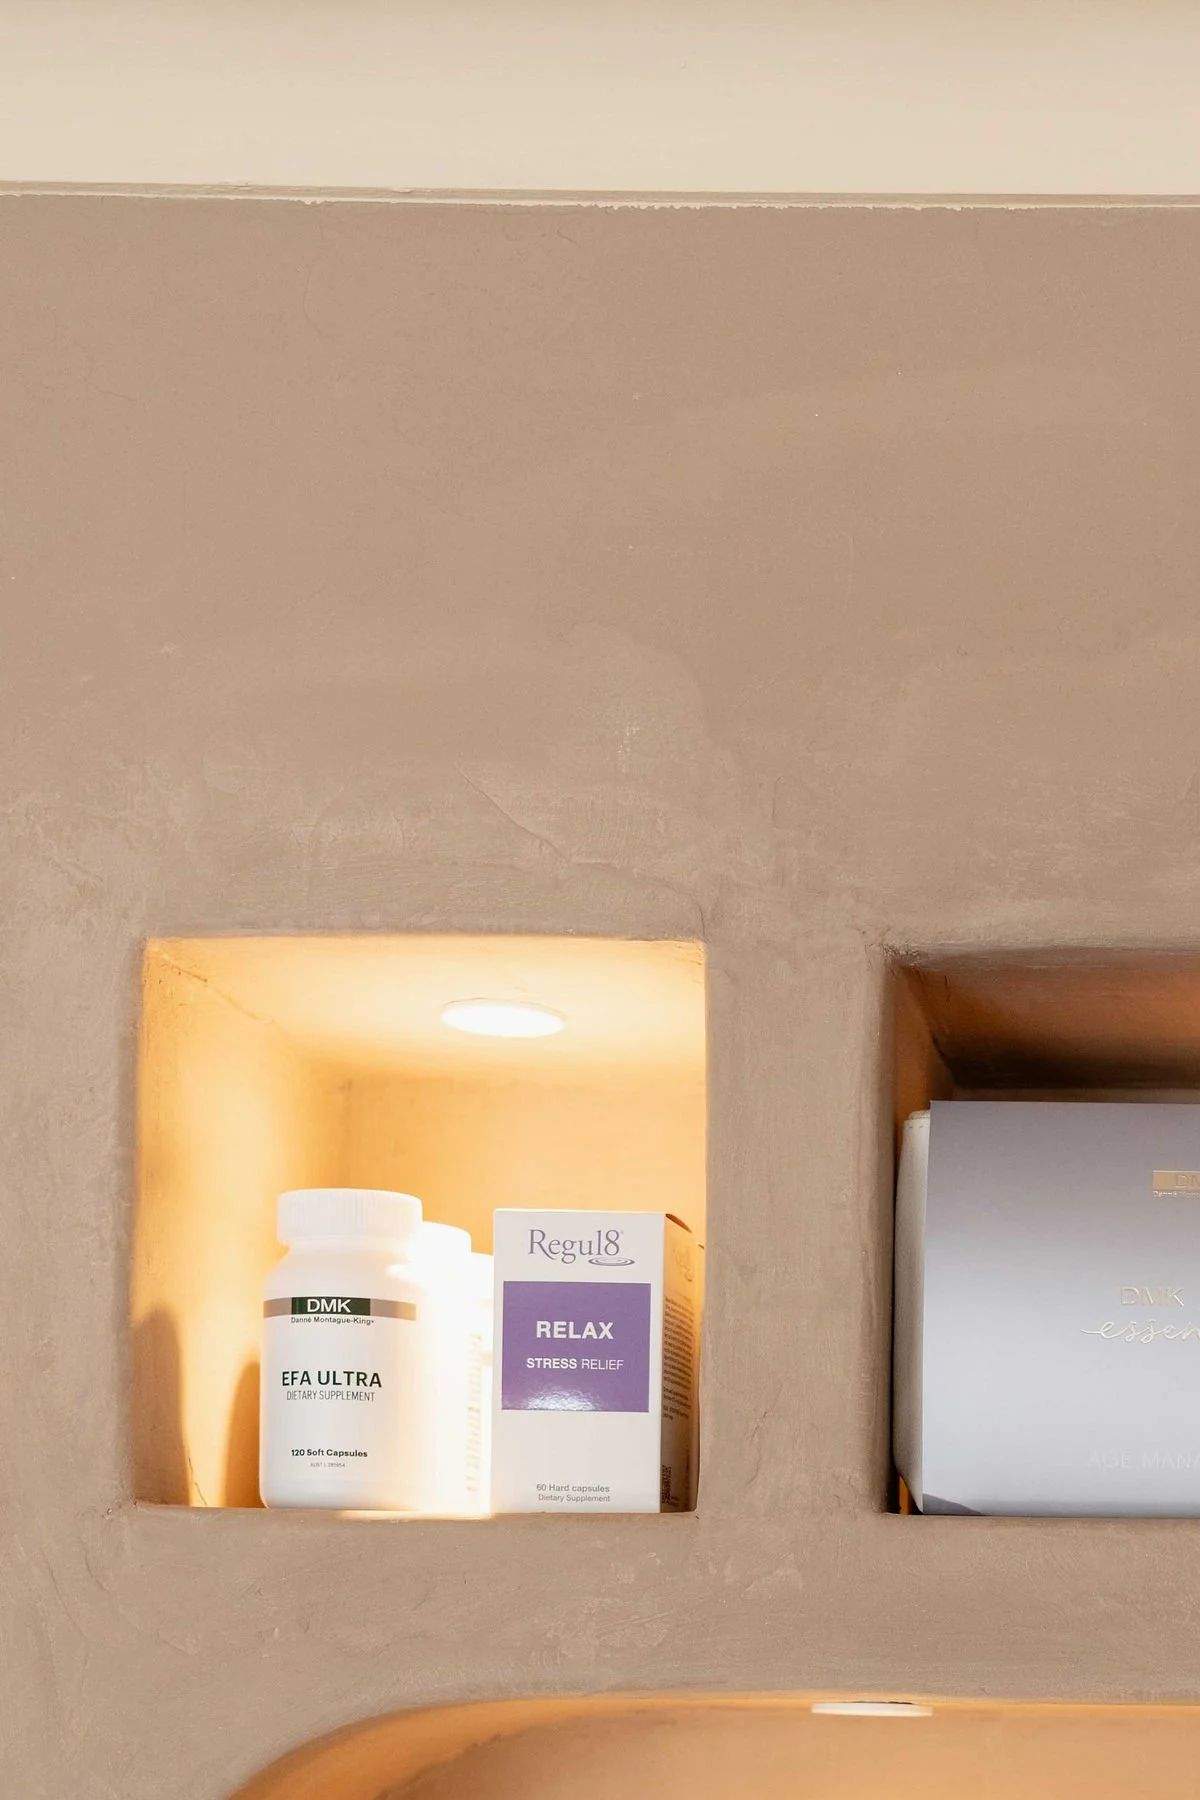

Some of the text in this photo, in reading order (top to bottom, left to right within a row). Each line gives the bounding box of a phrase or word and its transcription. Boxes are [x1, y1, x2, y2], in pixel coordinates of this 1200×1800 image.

[527, 1229, 621, 1264] Regul8
[1120, 1286, 1185, 1307] DMK
[308, 1299, 351, 1313] DMK
[536, 1320, 614, 1340] RELAX
[527, 1357, 624, 1371] STRESS RELIEF
[281, 1370, 383, 1389] EFA ULTRA
[286, 1390, 375, 1402] DIETARY SUPPLEMENT
[291, 1449, 369, 1460] 120 Soft Capsules
[1087, 1449, 1133, 1469] AGE
[536, 1484, 610, 1495] 60 Hard capsules
[538, 1493, 611, 1504] Dietary Supplement
